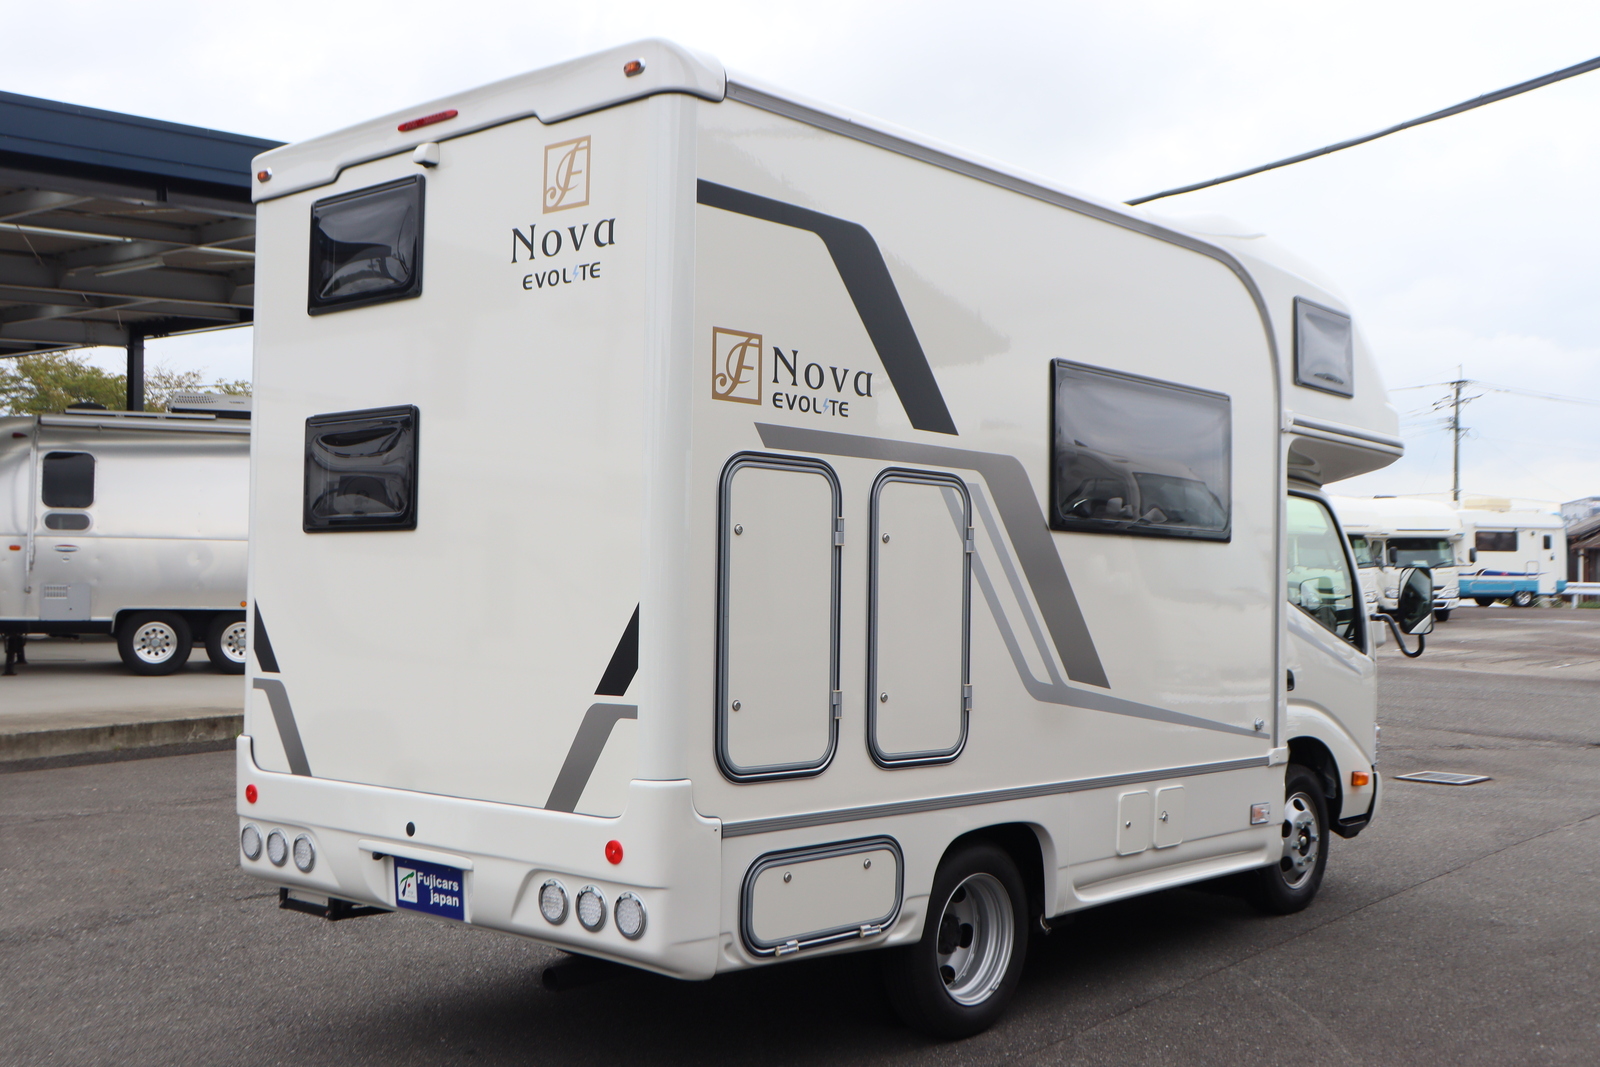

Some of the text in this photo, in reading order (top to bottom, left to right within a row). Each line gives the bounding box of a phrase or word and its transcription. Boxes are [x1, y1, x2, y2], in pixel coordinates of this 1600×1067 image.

[511, 217, 616, 264] Nova
[772, 346, 874, 398] Nova
[417, 872, 459, 891] Fujicars
[430, 889, 459, 907] japan
